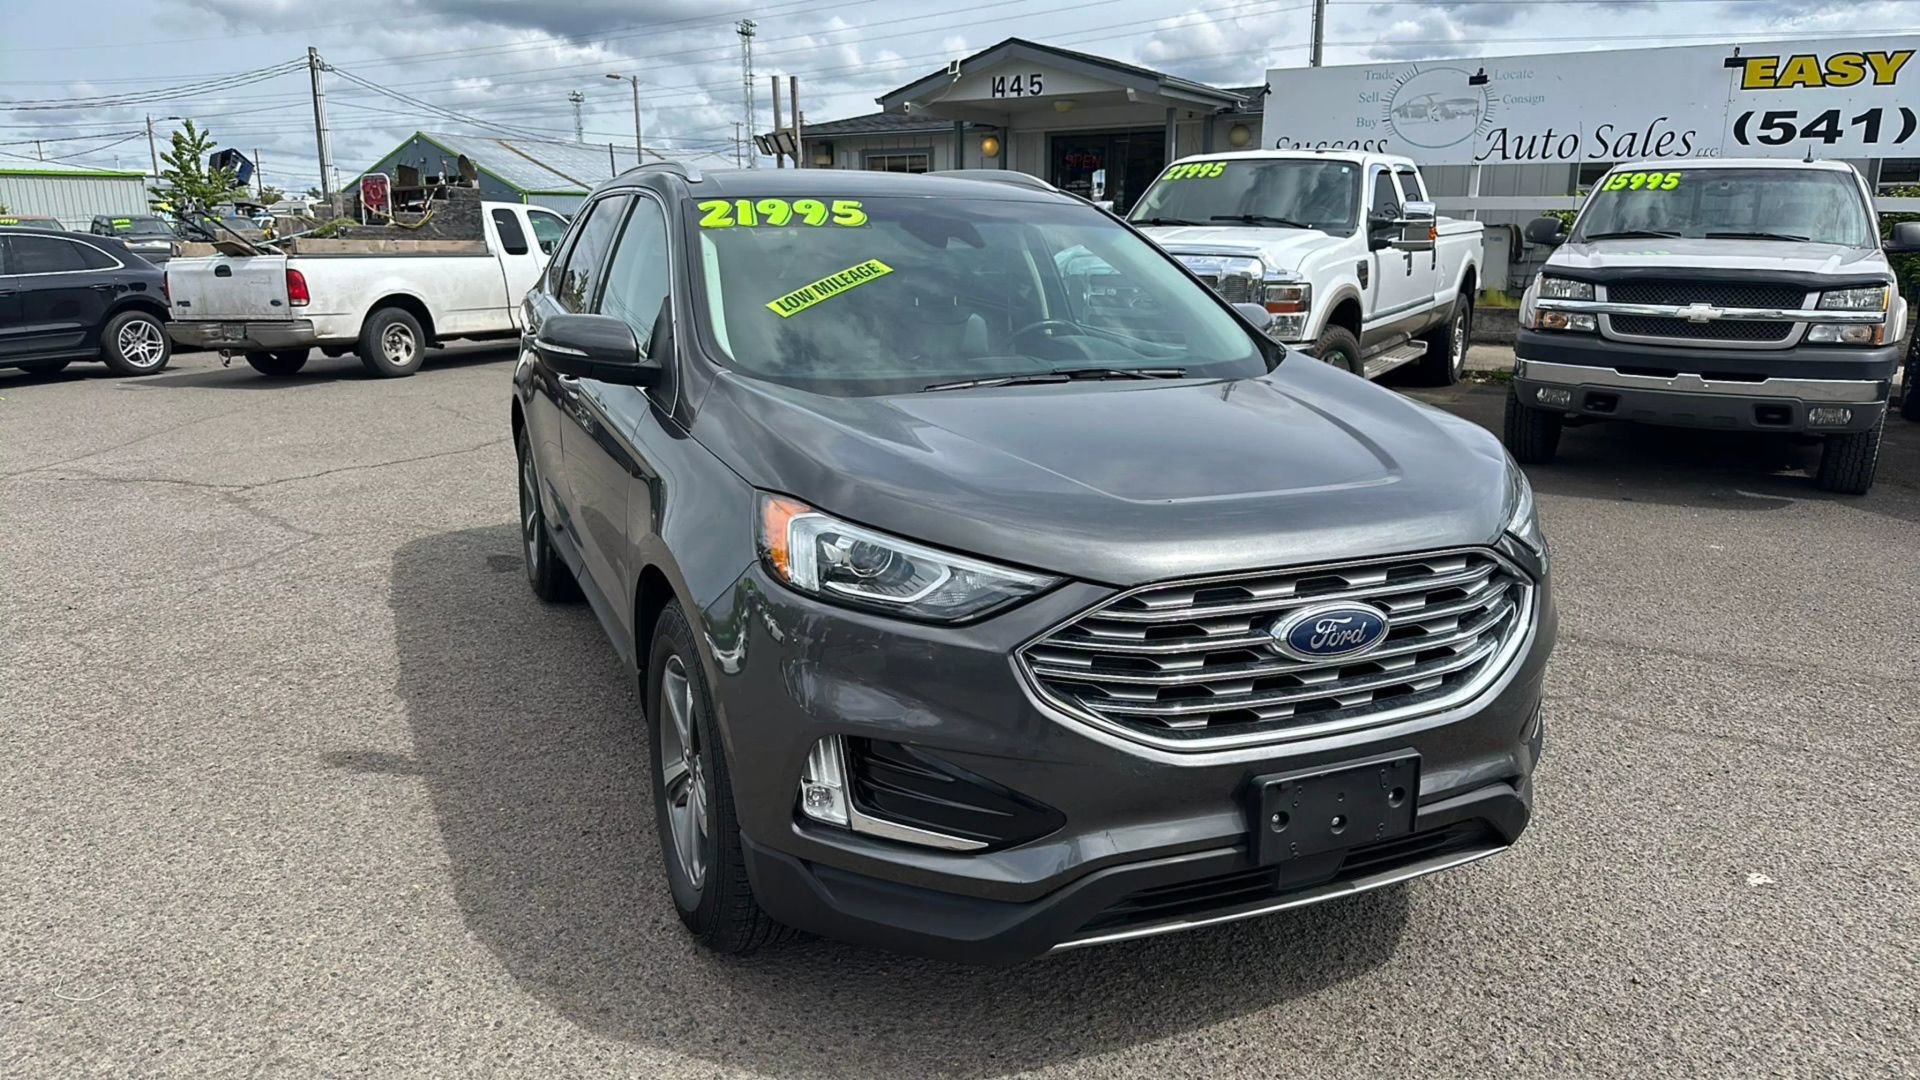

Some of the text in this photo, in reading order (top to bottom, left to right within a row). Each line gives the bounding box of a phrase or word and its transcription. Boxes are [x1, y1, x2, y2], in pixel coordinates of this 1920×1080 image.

[1364, 70, 1396, 81] Trade
[1494, 69, 1534, 80] Locate
[1740, 49, 1917, 90] EASY
[992, 74, 1043, 98] 1445
[1358, 92, 1380, 103] Sell
[1503, 93, 1545, 105] Consign
[1356, 117, 1378, 130] Buy
[1733, 107, 1917, 145] (541)
[1474, 127, 1580, 162] Auto
[1588, 117, 1697, 159] Sales
[1162, 162, 1228, 181] 27995
[1602, 172, 1682, 192] 15995
[697, 199, 868, 227] 21995
[775, 262, 881, 313] LOW MILEAGE
[1310, 616, 1367, 649] Ford
